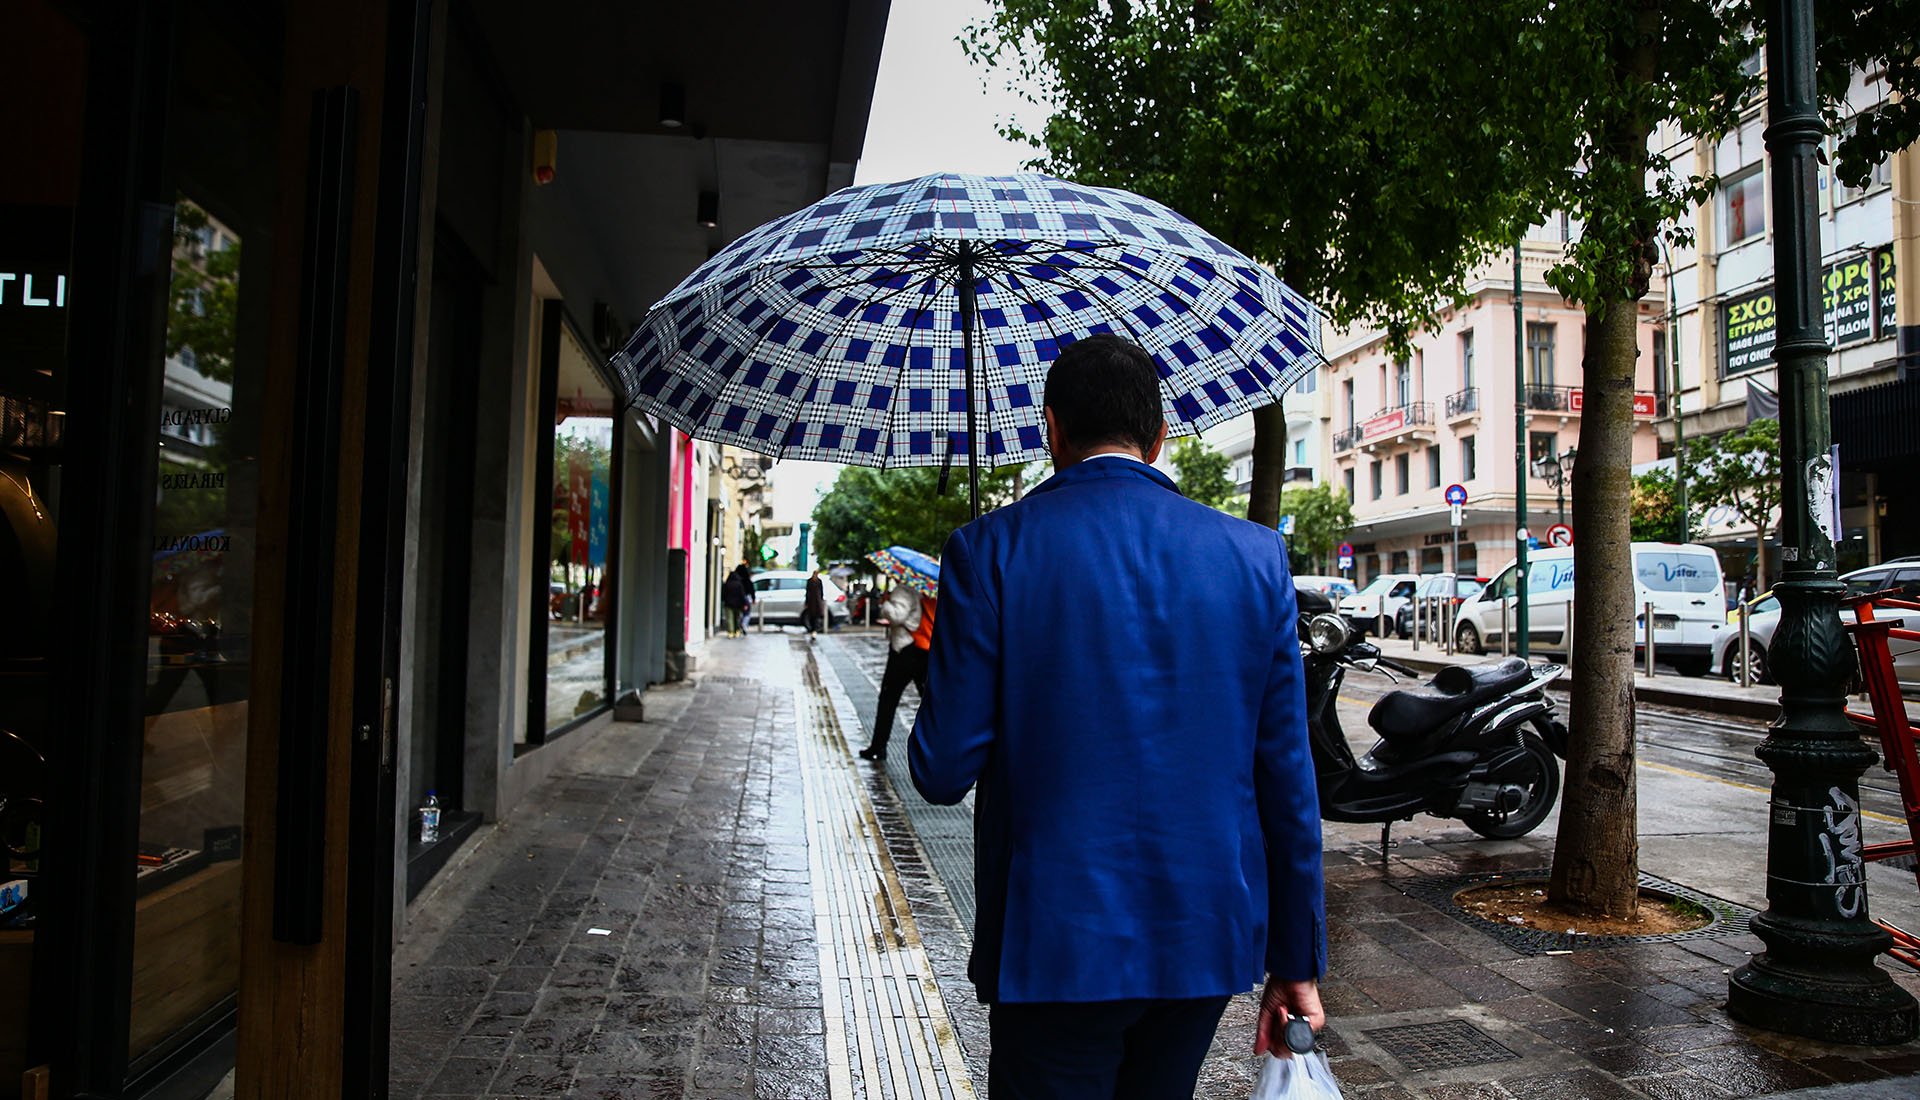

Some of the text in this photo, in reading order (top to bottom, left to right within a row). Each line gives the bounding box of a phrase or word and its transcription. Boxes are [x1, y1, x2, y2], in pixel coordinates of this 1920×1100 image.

[1728, 295, 1776, 325] ΣΧΟ
[1728, 316, 1776, 339] ΕΓΓΡΑΦ
[1729, 353, 1749, 368] ΠΟΥ
[1824, 323, 1835, 346] 5
